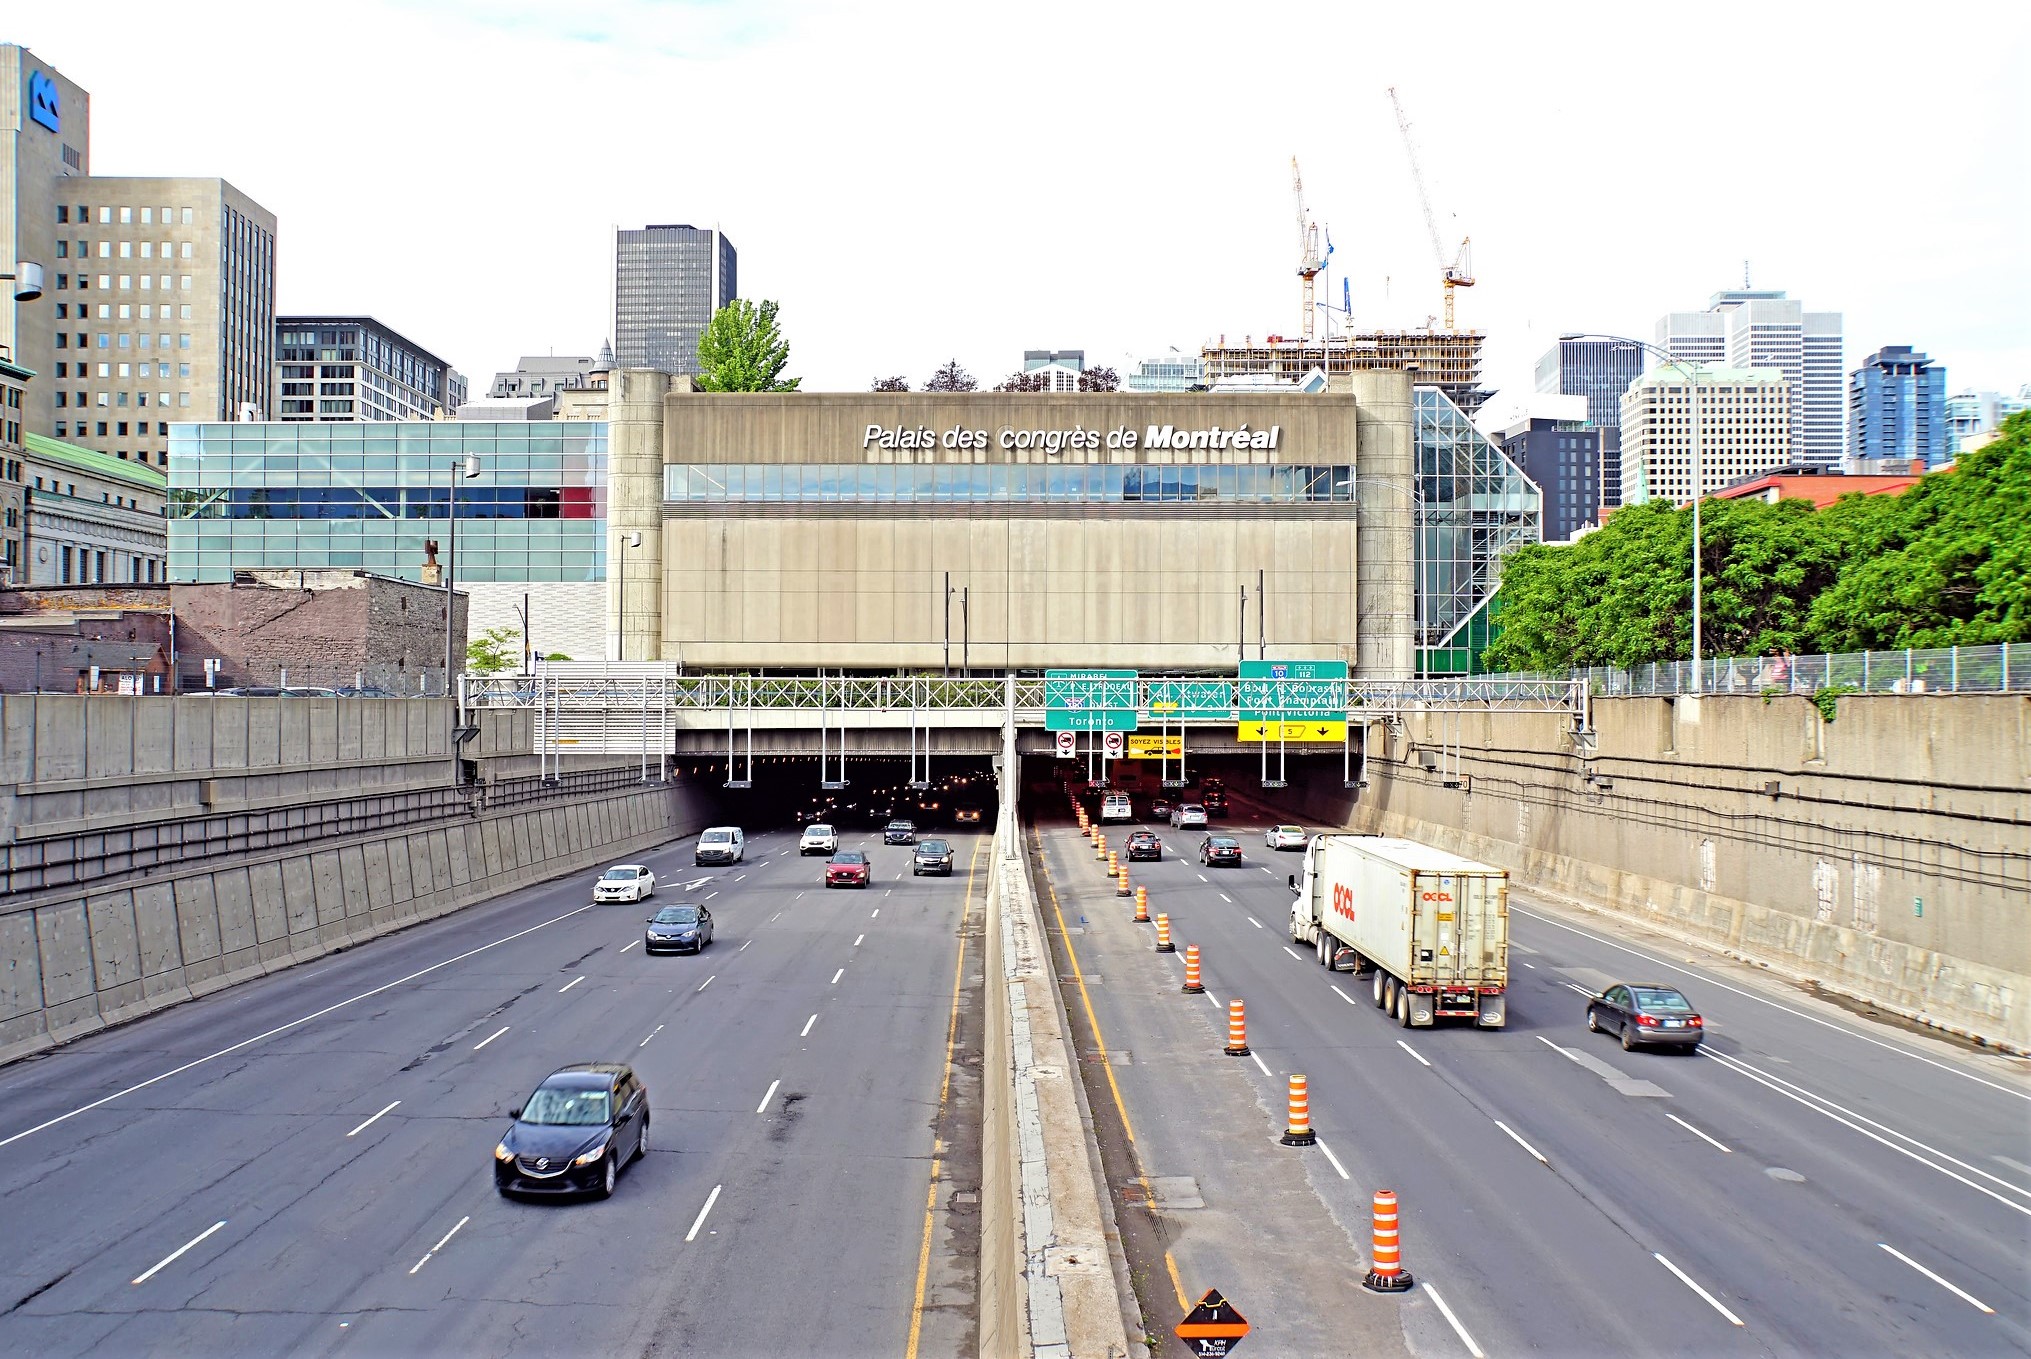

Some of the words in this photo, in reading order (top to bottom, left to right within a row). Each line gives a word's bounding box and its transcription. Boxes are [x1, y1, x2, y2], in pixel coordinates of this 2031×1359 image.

[863, 424, 936, 449] Palais
[942, 424, 989, 449] des
[1000, 424, 1100, 454] congrès
[1106, 424, 1138, 449] de
[1144, 423, 1280, 449] Montréal
